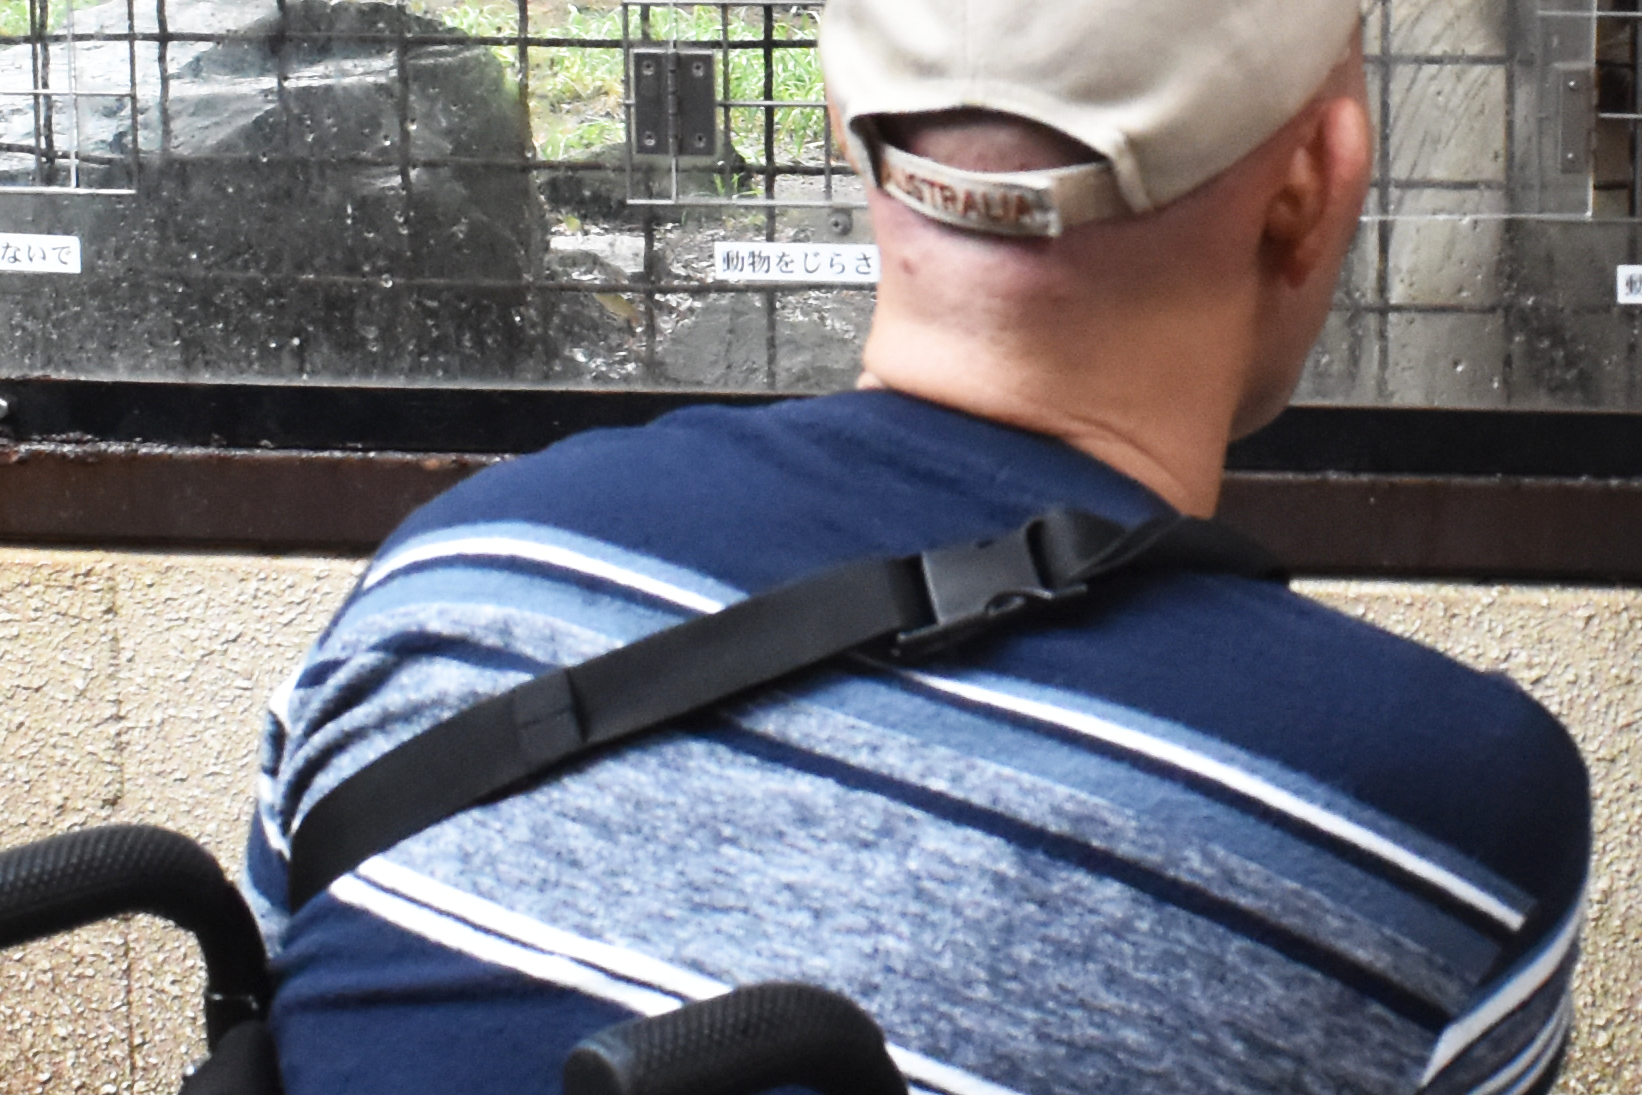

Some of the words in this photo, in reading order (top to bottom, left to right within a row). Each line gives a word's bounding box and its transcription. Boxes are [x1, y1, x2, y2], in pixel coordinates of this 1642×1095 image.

[722, 250, 872, 275] 動物をじらさ
